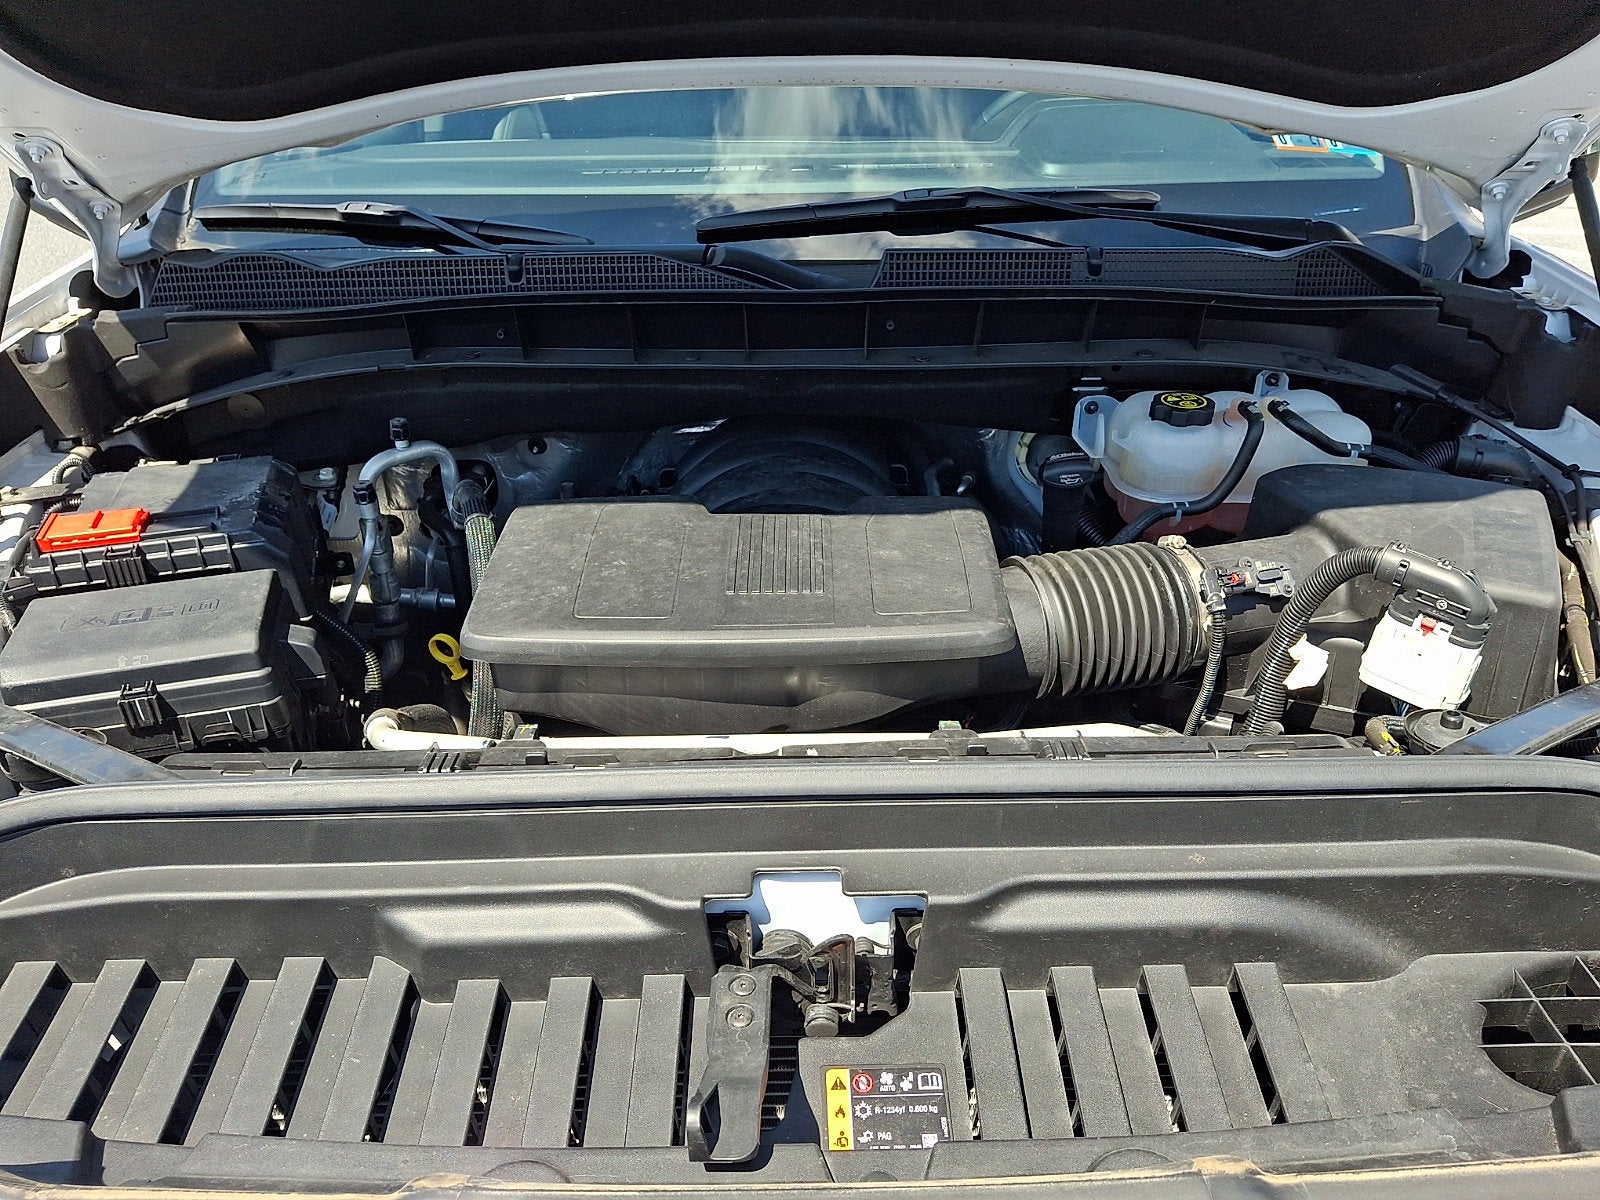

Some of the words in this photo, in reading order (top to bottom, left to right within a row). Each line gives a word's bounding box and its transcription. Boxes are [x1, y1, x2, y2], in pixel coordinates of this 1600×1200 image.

[879, 1084, 896, 1092] AUTO
[929, 1104, 939, 1114] kg
[877, 1131, 893, 1141] PAG
